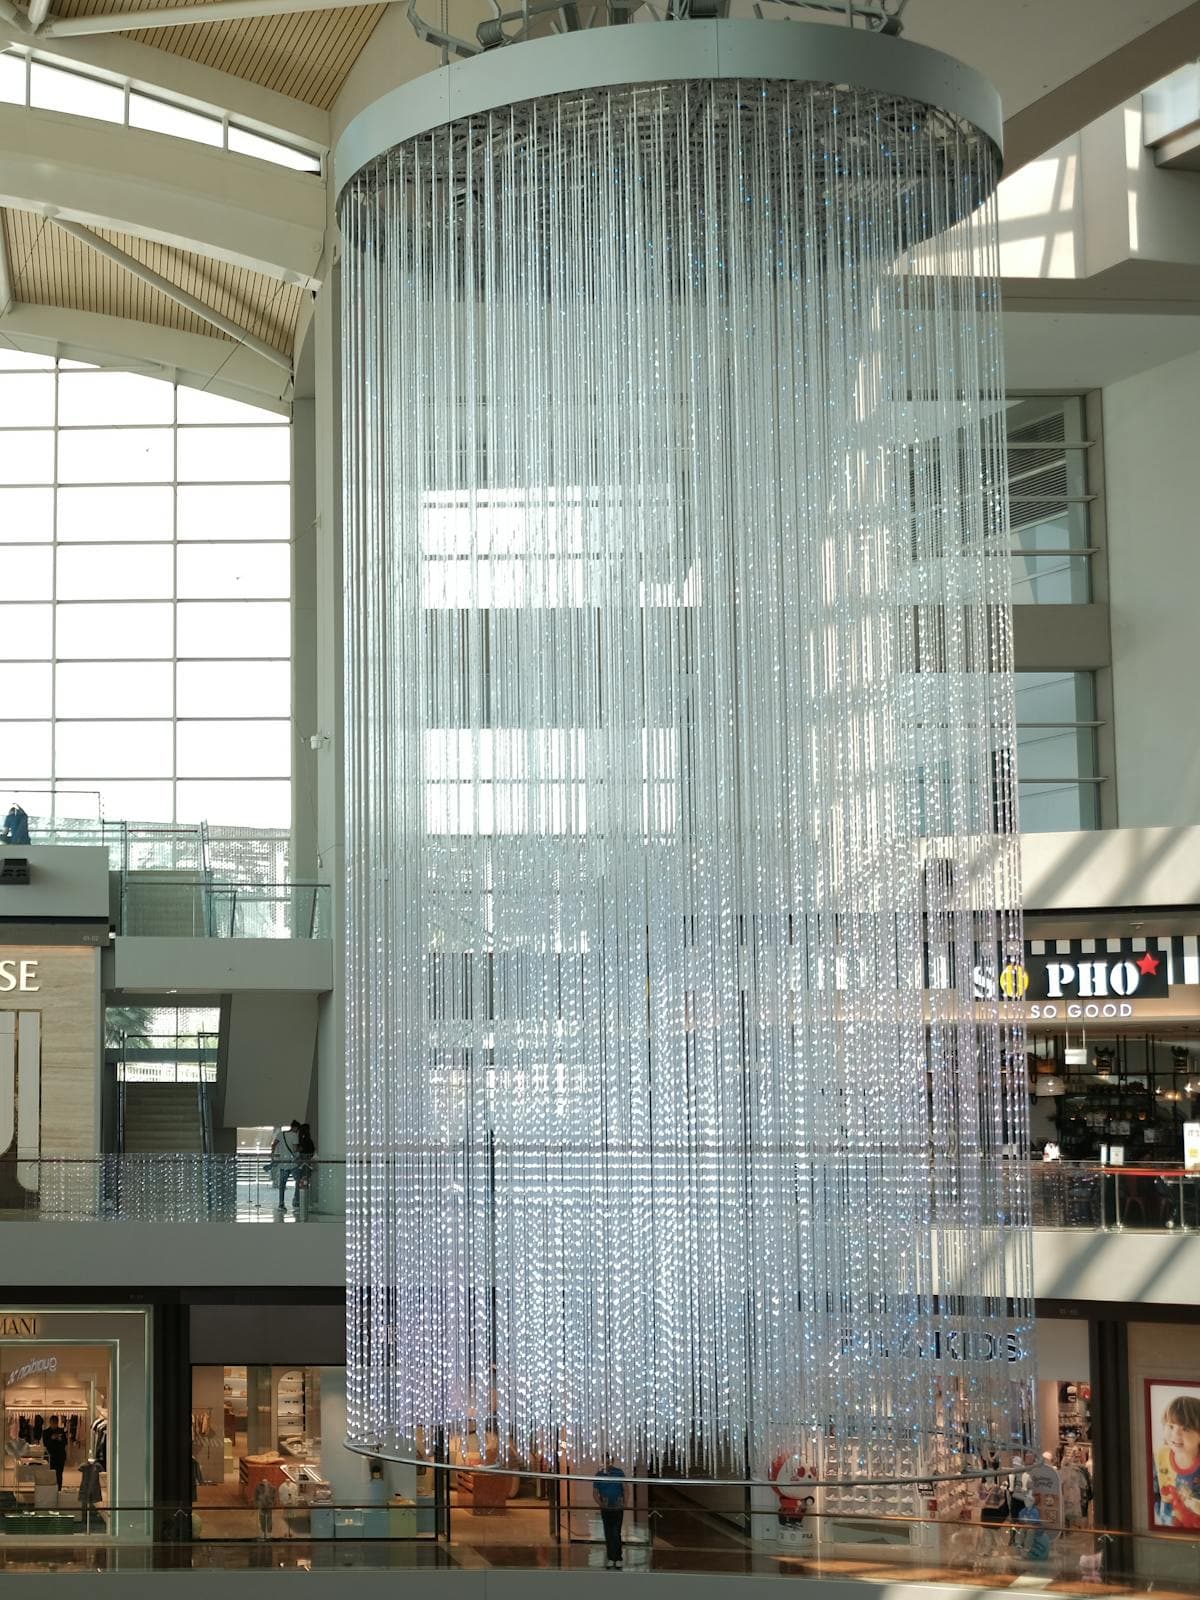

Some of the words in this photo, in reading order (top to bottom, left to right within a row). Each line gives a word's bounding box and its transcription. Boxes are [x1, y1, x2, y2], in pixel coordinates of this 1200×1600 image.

[1046, 960, 1140, 998] PHO
[1030, 1004, 1057, 1019] SO
[1067, 1003, 1132, 1018] GOOD
